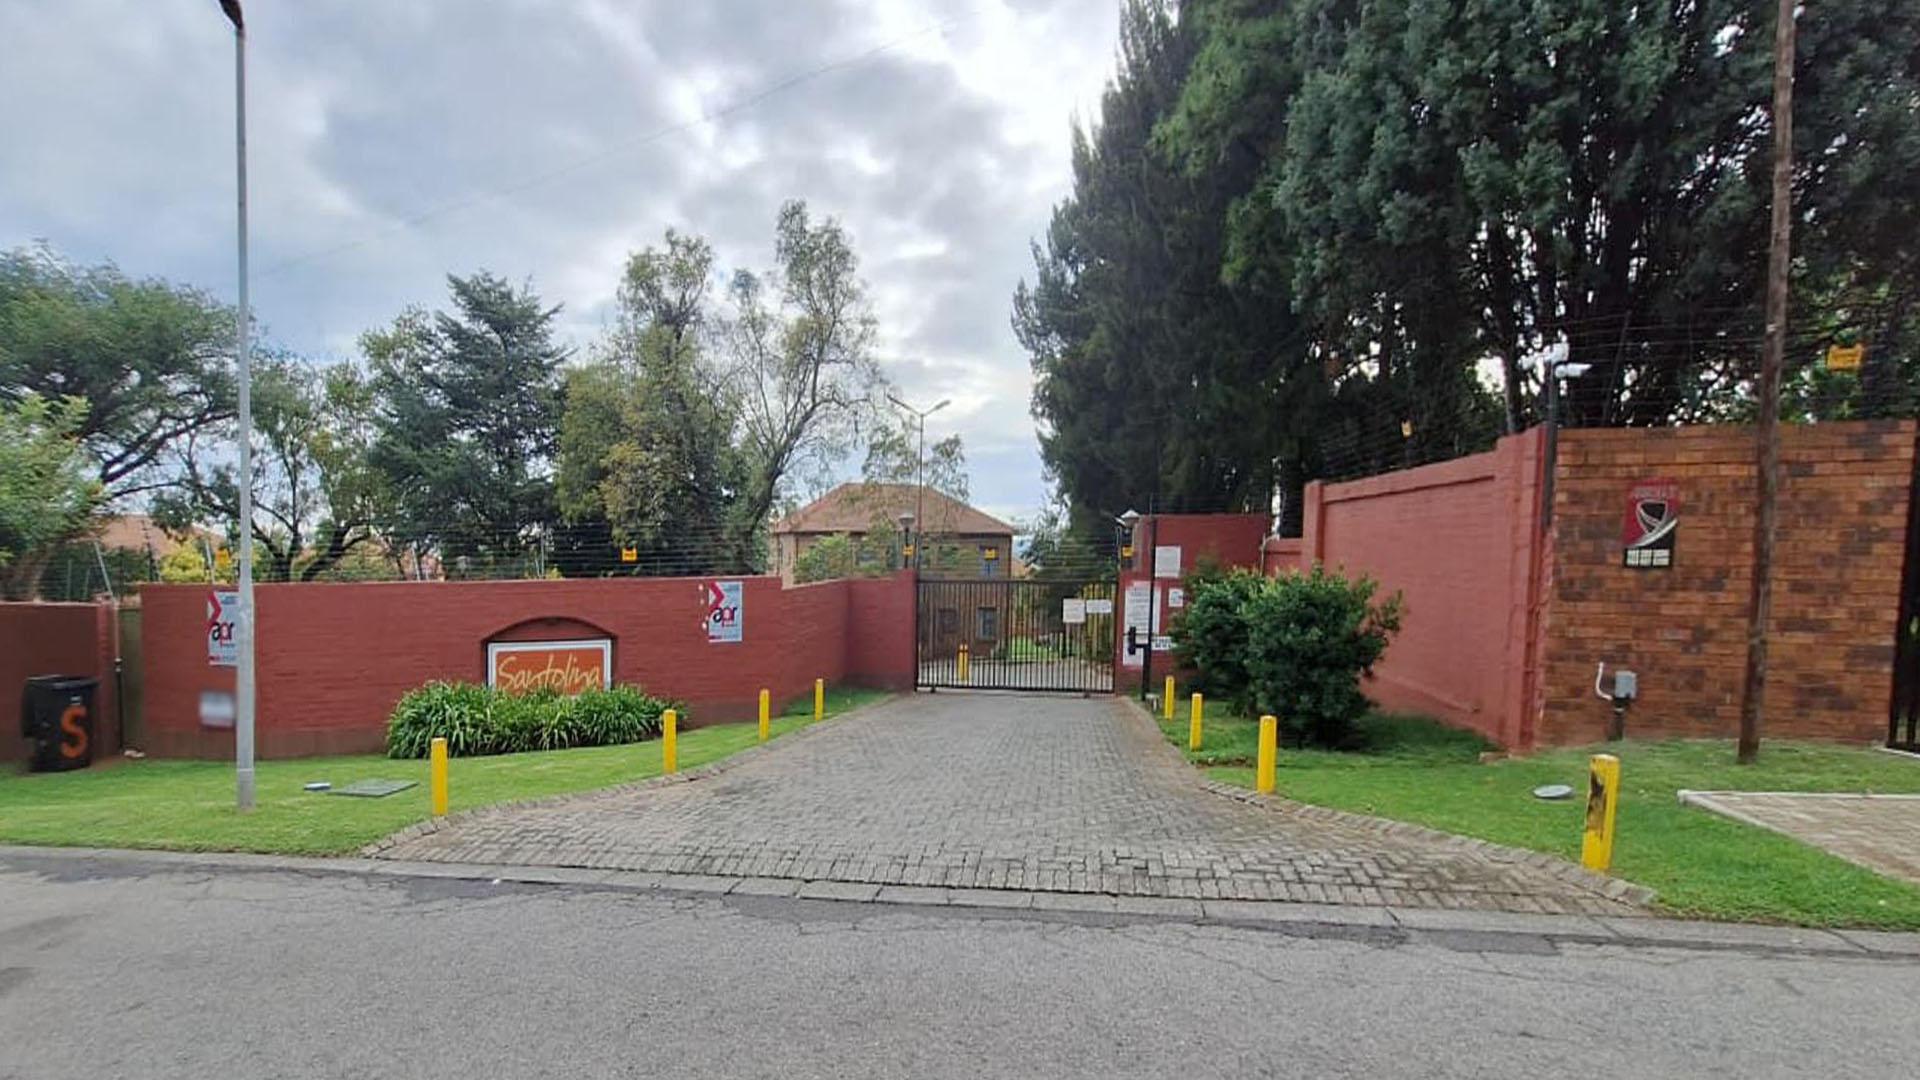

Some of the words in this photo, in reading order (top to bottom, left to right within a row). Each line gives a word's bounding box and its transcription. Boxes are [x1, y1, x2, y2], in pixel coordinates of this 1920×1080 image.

[712, 607, 738, 627] apr
[211, 622, 235, 648] apr
[498, 652, 601, 691] Santolina
[61, 705, 88, 759] S
